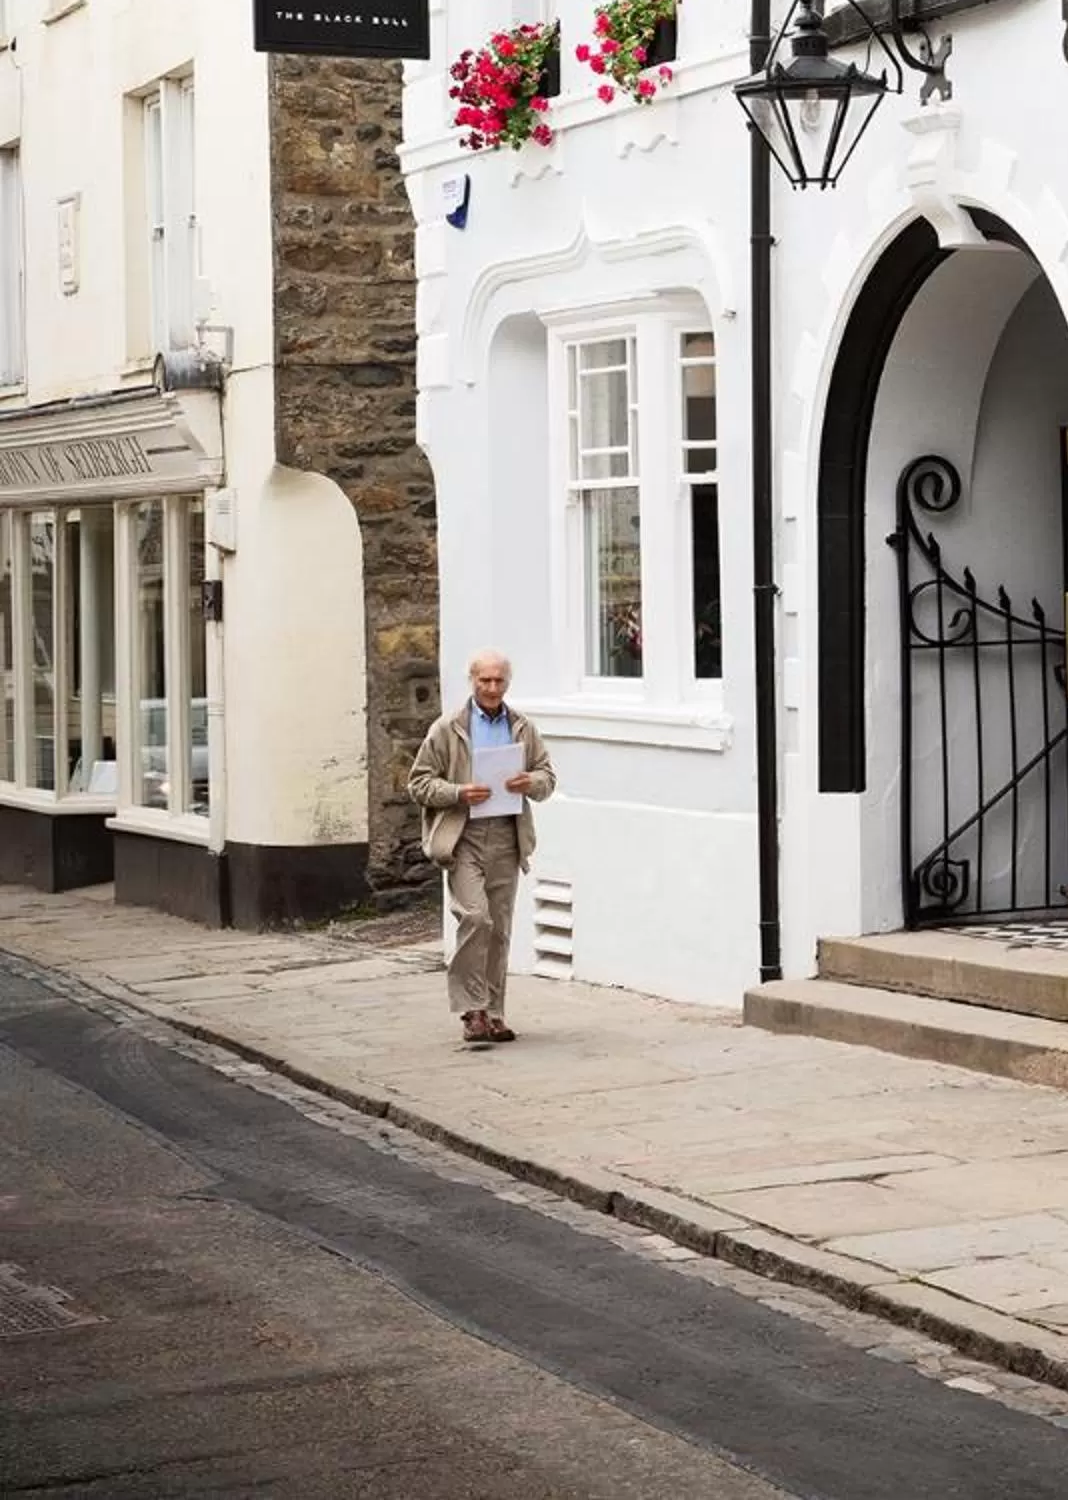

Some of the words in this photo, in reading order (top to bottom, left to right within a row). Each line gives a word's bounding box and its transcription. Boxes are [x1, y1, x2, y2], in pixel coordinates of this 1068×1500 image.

[275, 11, 304, 21] THE
[313, 13, 363, 23] BLACK
[372, 16, 408, 27] BULL
[38, 446, 64, 482] OF
[64, 436, 153, 479] SEDBERGH
